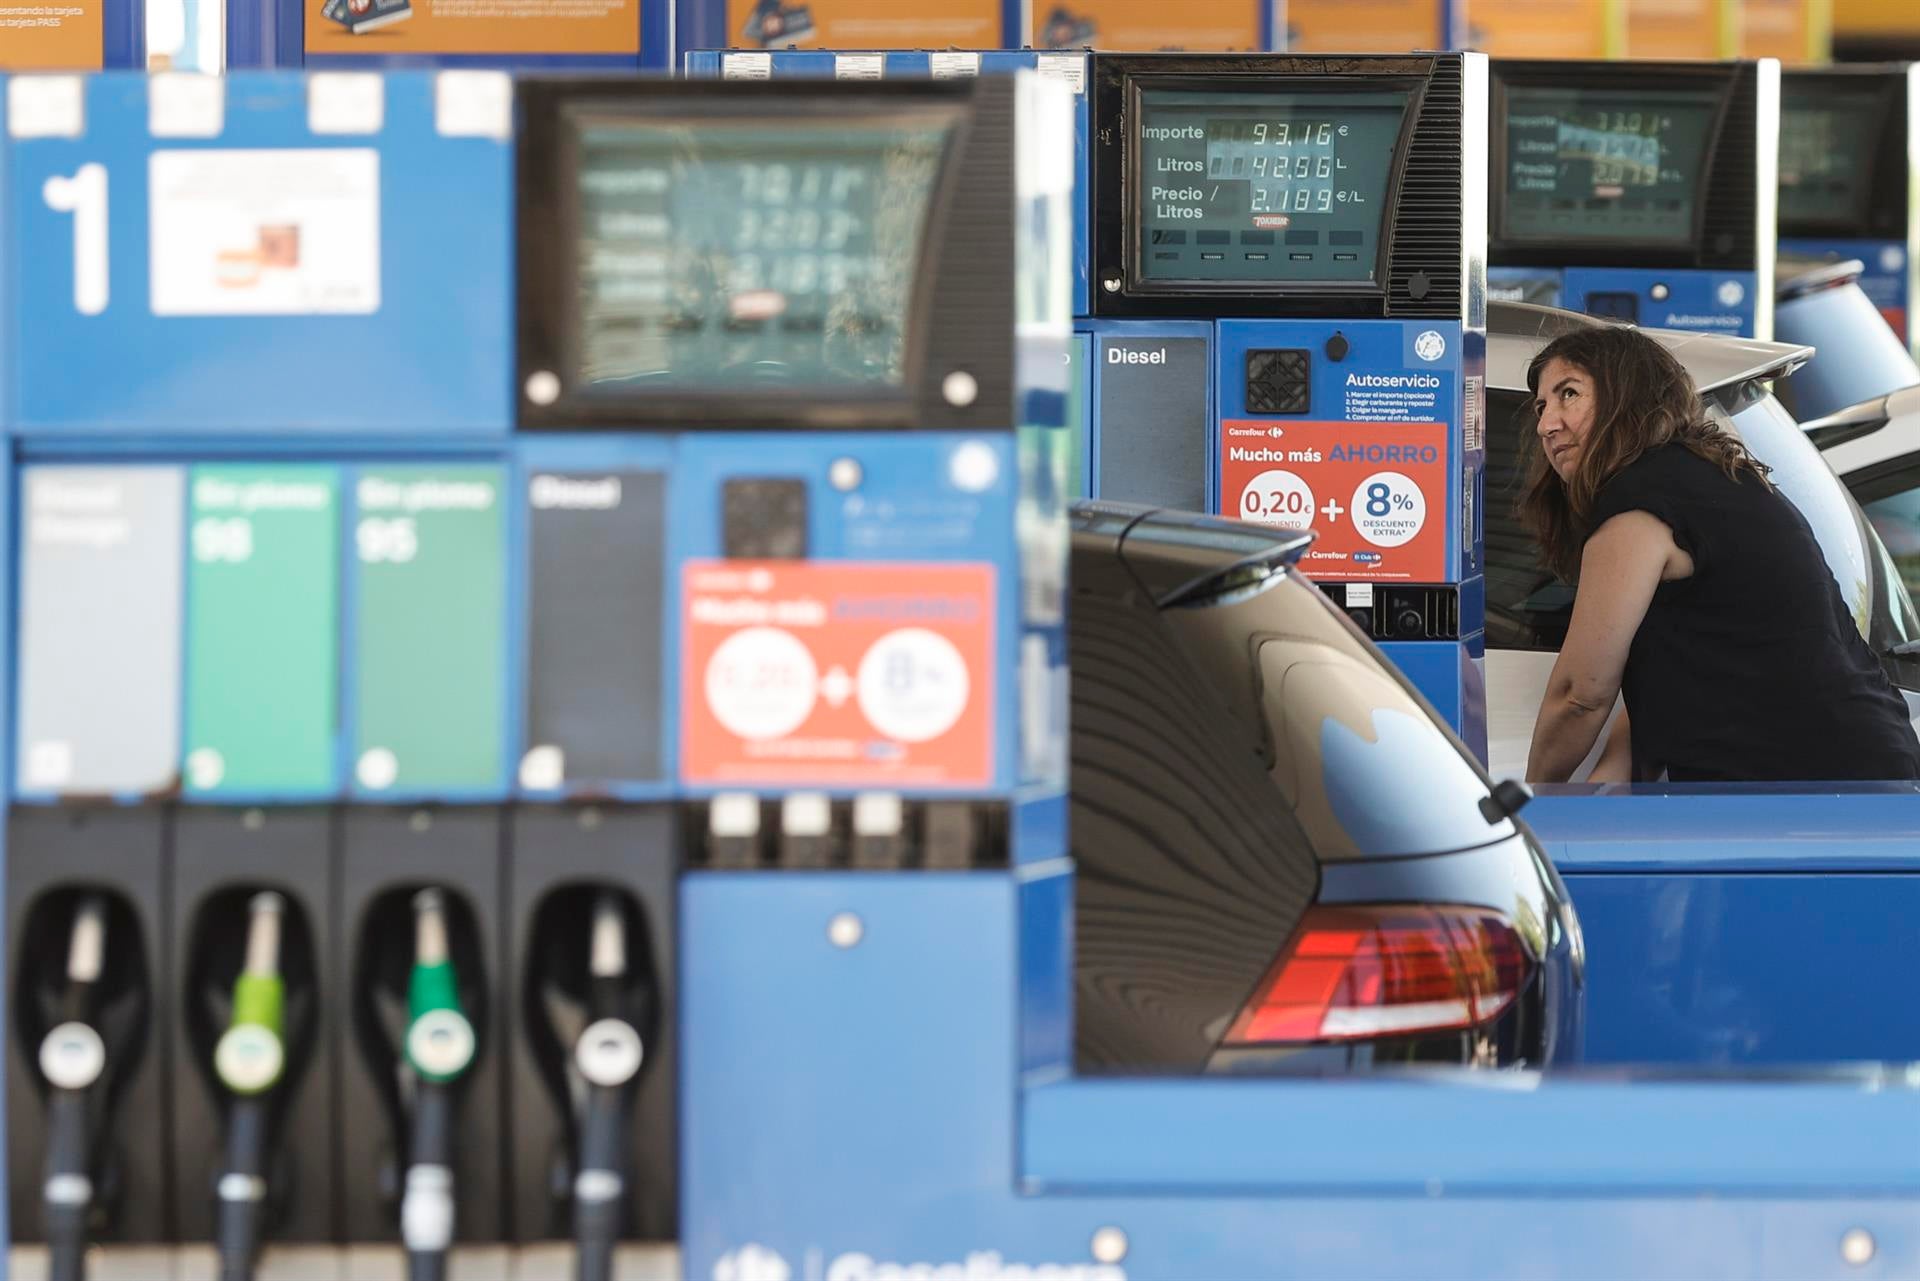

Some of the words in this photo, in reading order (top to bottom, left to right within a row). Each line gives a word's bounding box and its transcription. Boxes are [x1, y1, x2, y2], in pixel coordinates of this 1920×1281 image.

[37, 17, 61, 26] PASS
[1141, 125, 1204, 141] Importe
[1254, 123, 1331, 146] 93,16
[1338, 125, 1348, 136] €
[1157, 157, 1204, 172] Litros
[1253, 156, 1331, 180] 42,56
[1151, 186, 1203, 201] Precio
[1251, 189, 1332, 212] 2,189
[1336, 190, 1365, 203] €/L
[1157, 205, 1203, 219] Litros
[43, 162, 109, 316] 1
[1488, 287, 1523, 301] iesel
[1667, 313, 1743, 327] Autoservicio
[1108, 347, 1166, 364] Diesel
[1346, 373, 1440, 388] Autoservicio
[1352, 399, 1369, 407] Elegir
[1379, 392, 1403, 400] importe
[1404, 392, 1435, 400] (opcional)
[1229, 428, 1266, 436] Carrefour
[1230, 447, 1283, 461] Mucho
[1288, 447, 1322, 462] más
[1329, 444, 1438, 464] AHORRO
[1311, 551, 1348, 559] Carrefour
